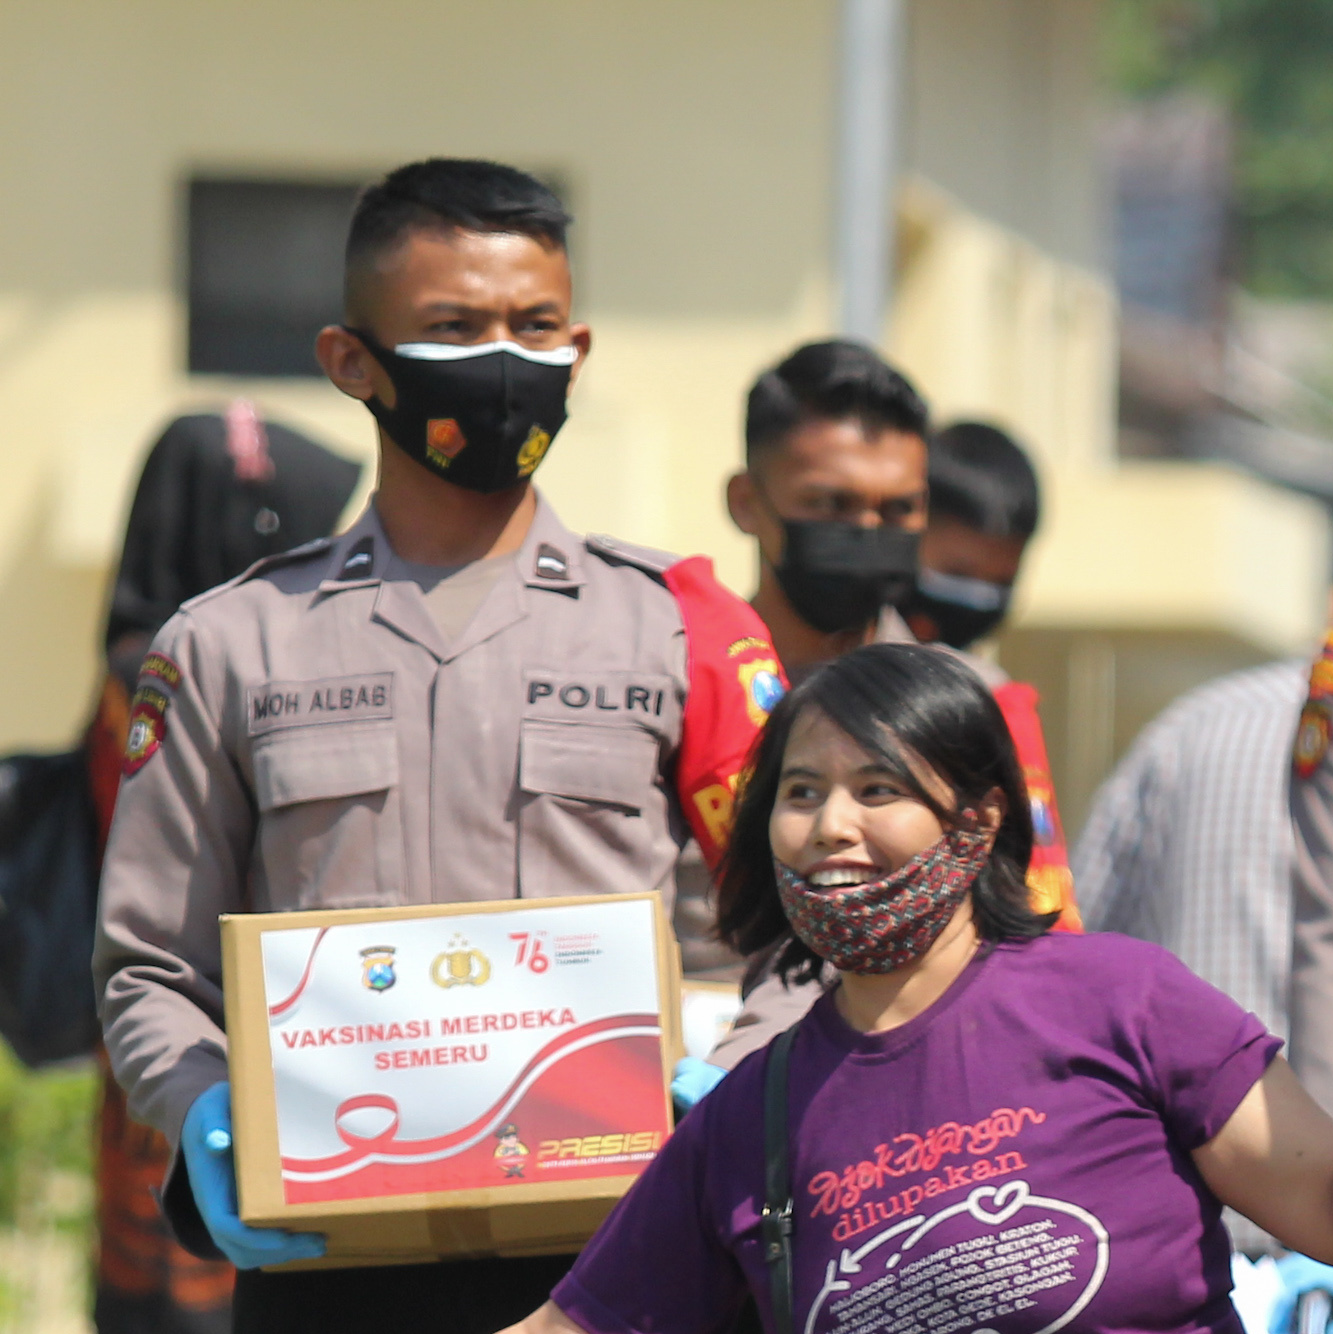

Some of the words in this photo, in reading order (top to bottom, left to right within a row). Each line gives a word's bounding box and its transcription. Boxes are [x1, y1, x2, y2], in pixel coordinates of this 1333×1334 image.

[253, 689, 299, 721] MOH
[526, 681, 664, 717] POLRI
[507, 931, 550, 975] 76
[280, 1018, 432, 1050] VAKSINASI
[440, 1007, 578, 1037] MERDEKA
[374, 1043, 489, 1071] SEMERU
[536, 1131, 663, 1160] PRESISI
[831, 1150, 1028, 1243] dilupakan
